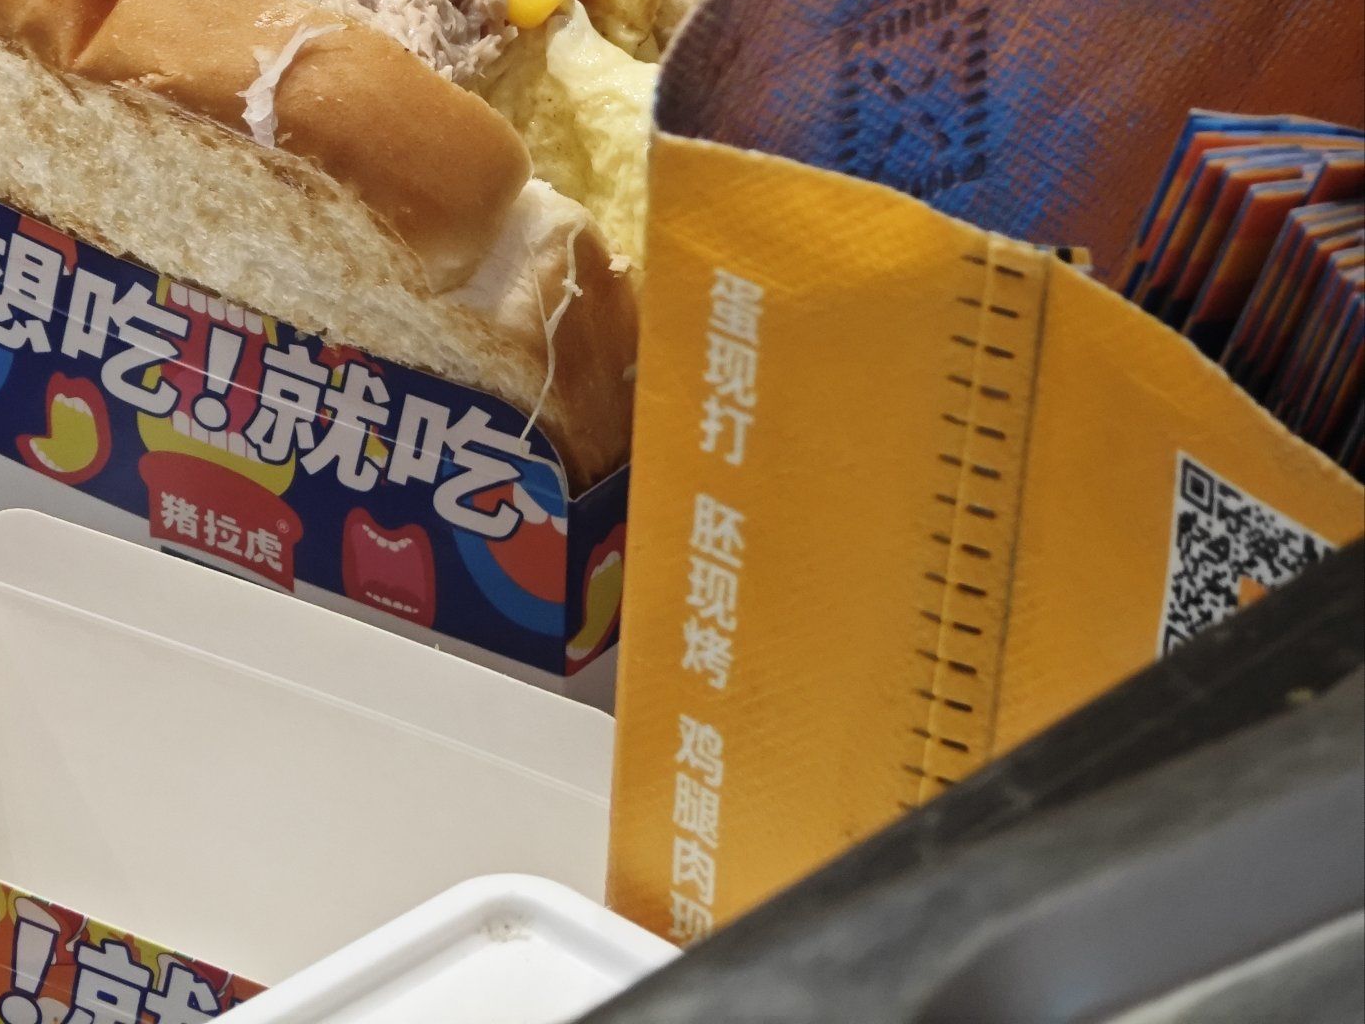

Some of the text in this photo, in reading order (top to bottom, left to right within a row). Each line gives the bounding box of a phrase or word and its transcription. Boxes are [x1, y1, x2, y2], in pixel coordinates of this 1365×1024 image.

[699, 267, 764, 465] 蛋现打
[160, 481, 283, 563] 猪拉虎
[682, 492, 745, 689] 胚现烤
